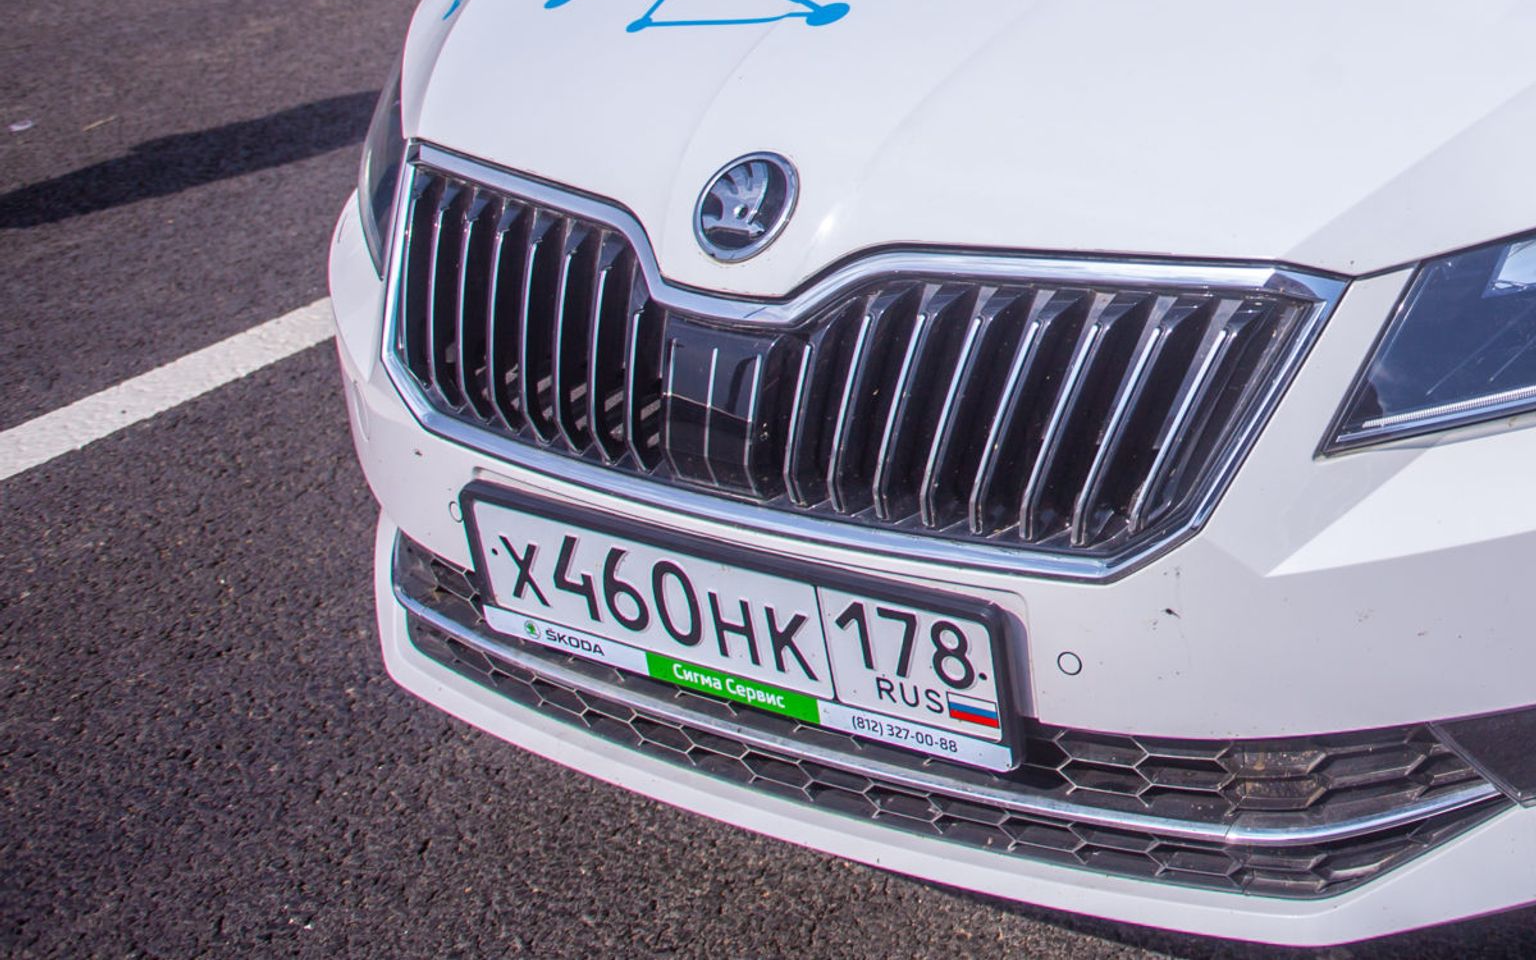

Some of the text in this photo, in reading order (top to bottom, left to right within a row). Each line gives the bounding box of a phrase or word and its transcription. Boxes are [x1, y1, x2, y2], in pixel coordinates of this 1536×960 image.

[545, 628, 605, 656] ŠKODA
[835, 601, 975, 690] 178
[672, 663, 786, 709] Сигма Сервис
[876, 677, 944, 714] RUS
[852, 715, 959, 753] (812) 327-00-88
